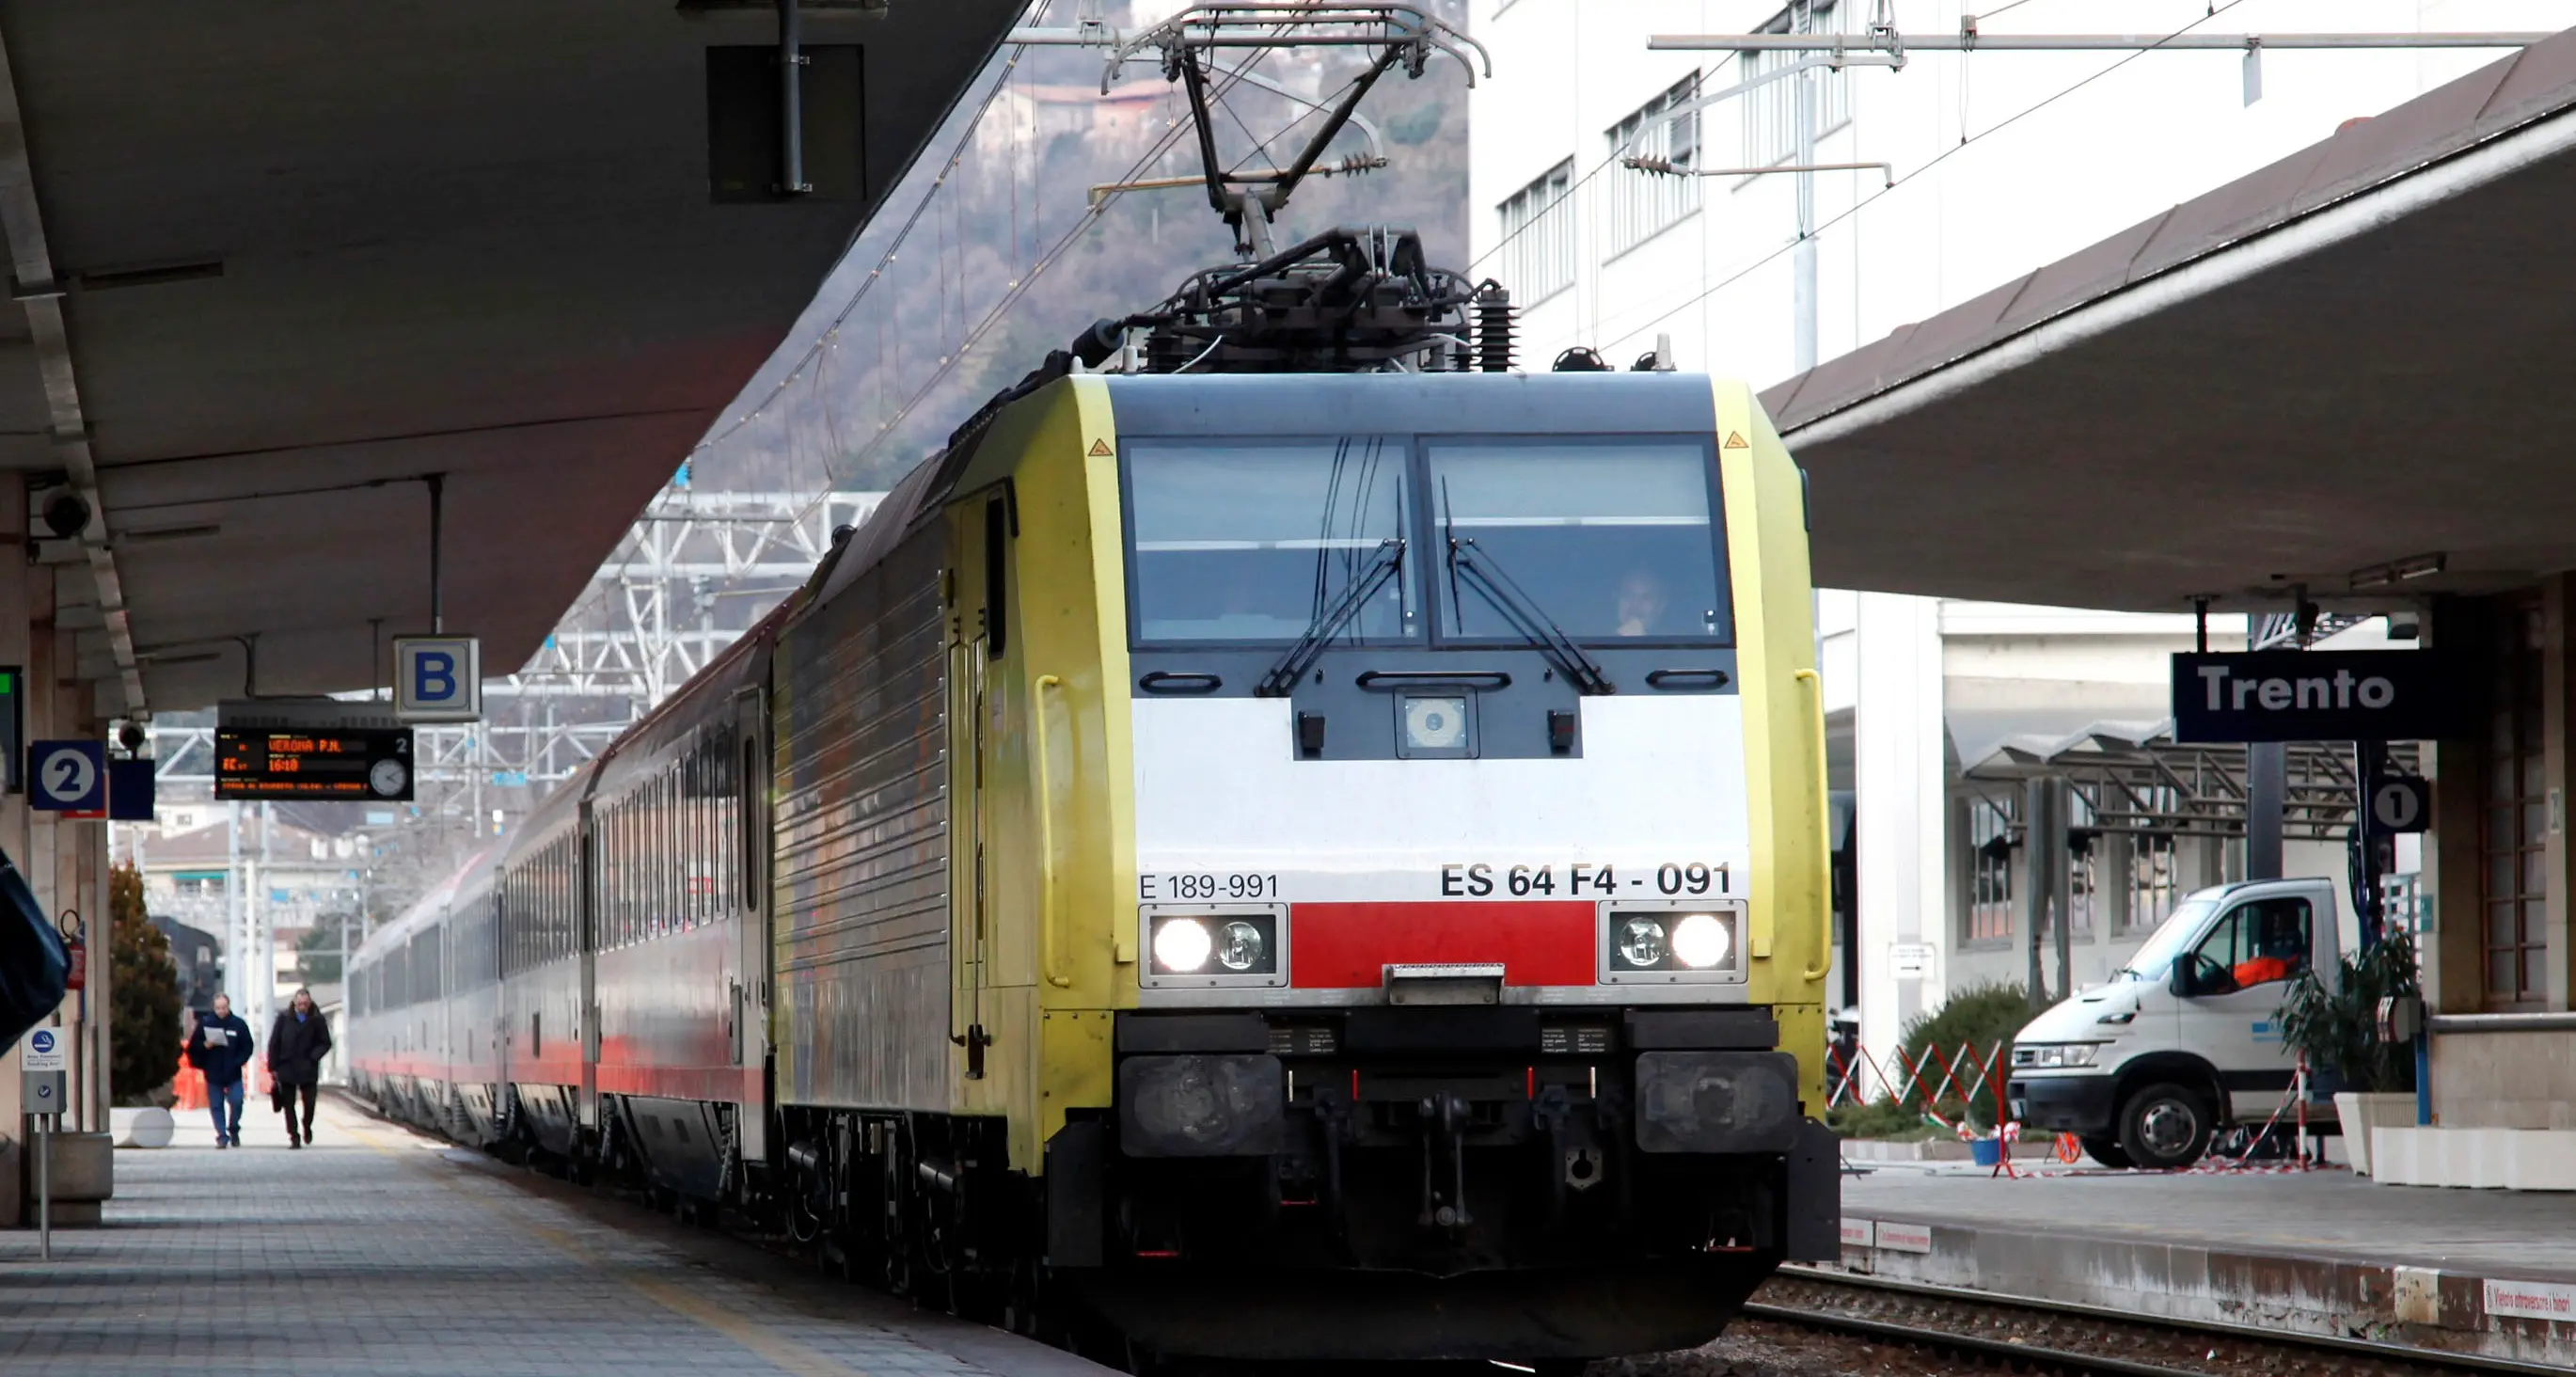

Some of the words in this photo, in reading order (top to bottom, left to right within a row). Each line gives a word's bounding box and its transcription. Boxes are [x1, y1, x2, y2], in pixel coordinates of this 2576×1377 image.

[415, 652, 456, 701] B
[2198, 666, 2394, 710] Trento
[269, 739, 314, 752] VERONA
[396, 737, 408, 752] 2
[54, 757, 81, 792] 2
[2390, 792, 2403, 820] 1
[1140, 875, 1156, 899] E
[1168, 874, 1277, 898] 189-991
[1442, 863, 1493, 896] ES
[1509, 863, 1555, 896] 64
[1571, 863, 1617, 895] F4
[1657, 862, 1730, 894] 091
